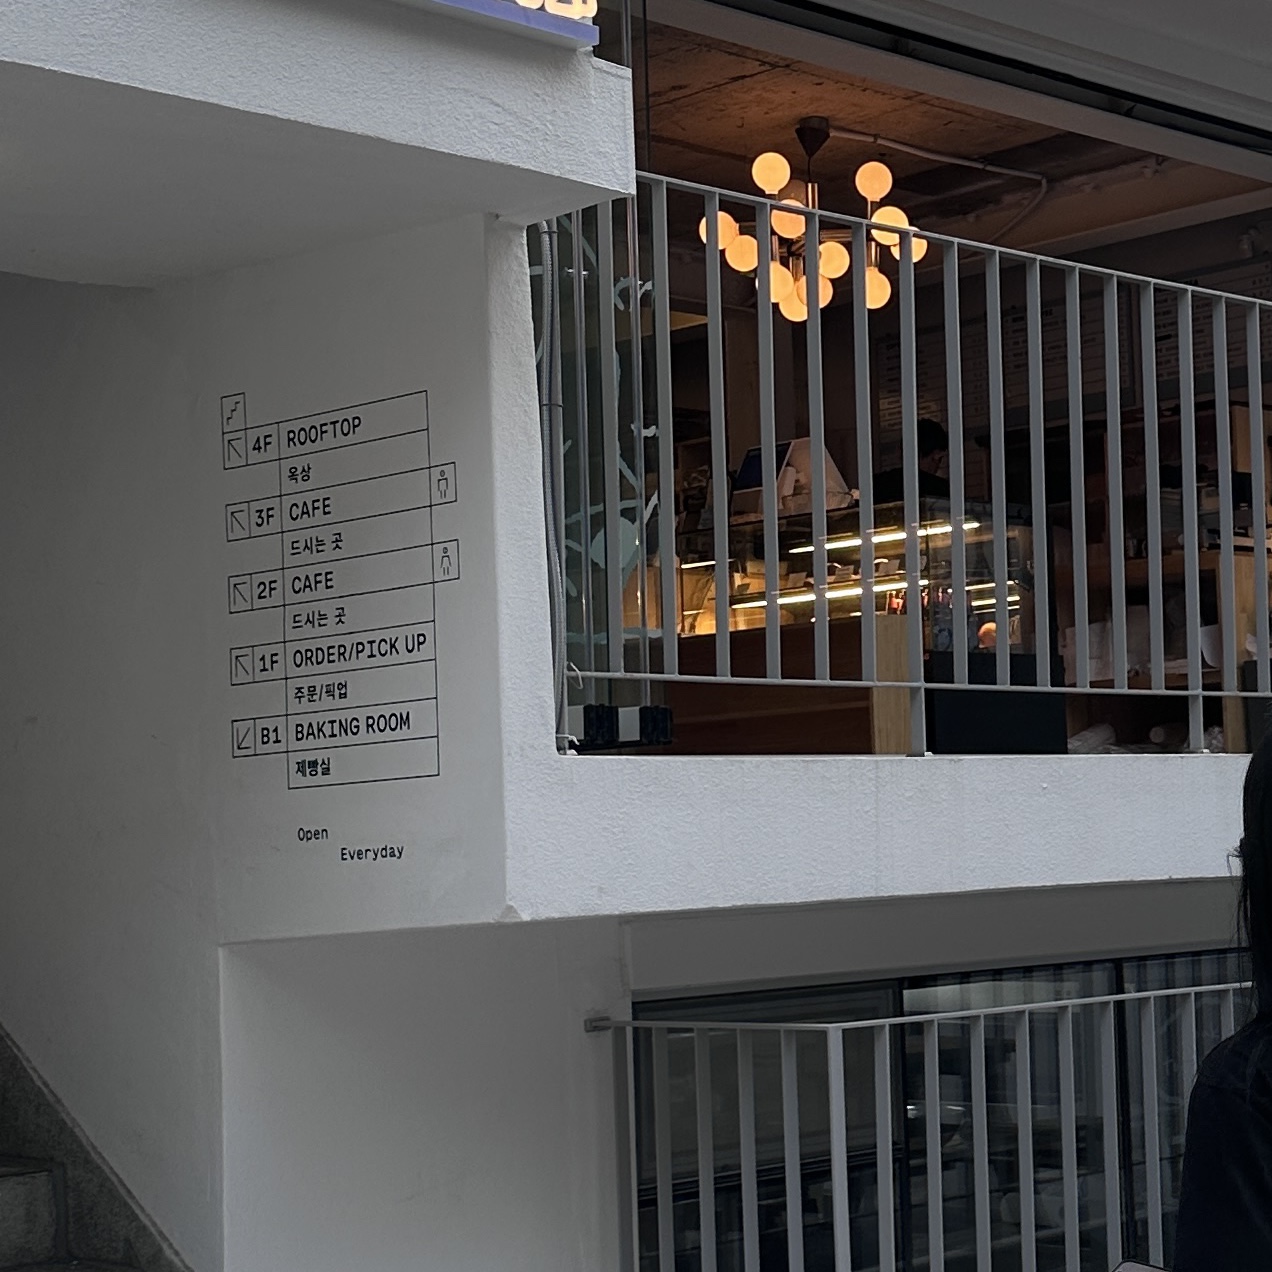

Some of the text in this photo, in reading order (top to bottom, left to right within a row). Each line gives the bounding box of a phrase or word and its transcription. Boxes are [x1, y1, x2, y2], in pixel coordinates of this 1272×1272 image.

[252, 416, 362, 453] 4F ROOFTOP
[288, 463, 311, 483] 옥상
[255, 497, 331, 527] 3F CAFE
[290, 532, 343, 555] 드시는 곳
[257, 571, 334, 599] 2F CAFE
[292, 607, 346, 629] 드시는 곳
[259, 633, 427, 672] 1F ORDER/PICK UP
[294, 681, 348, 704] 주문/픽업
[261, 711, 410, 745] B1 BAKING ROOM
[296, 757, 331, 777] 제빵실
[298, 827, 328, 842] Open
[341, 845, 403, 861] Everyday
